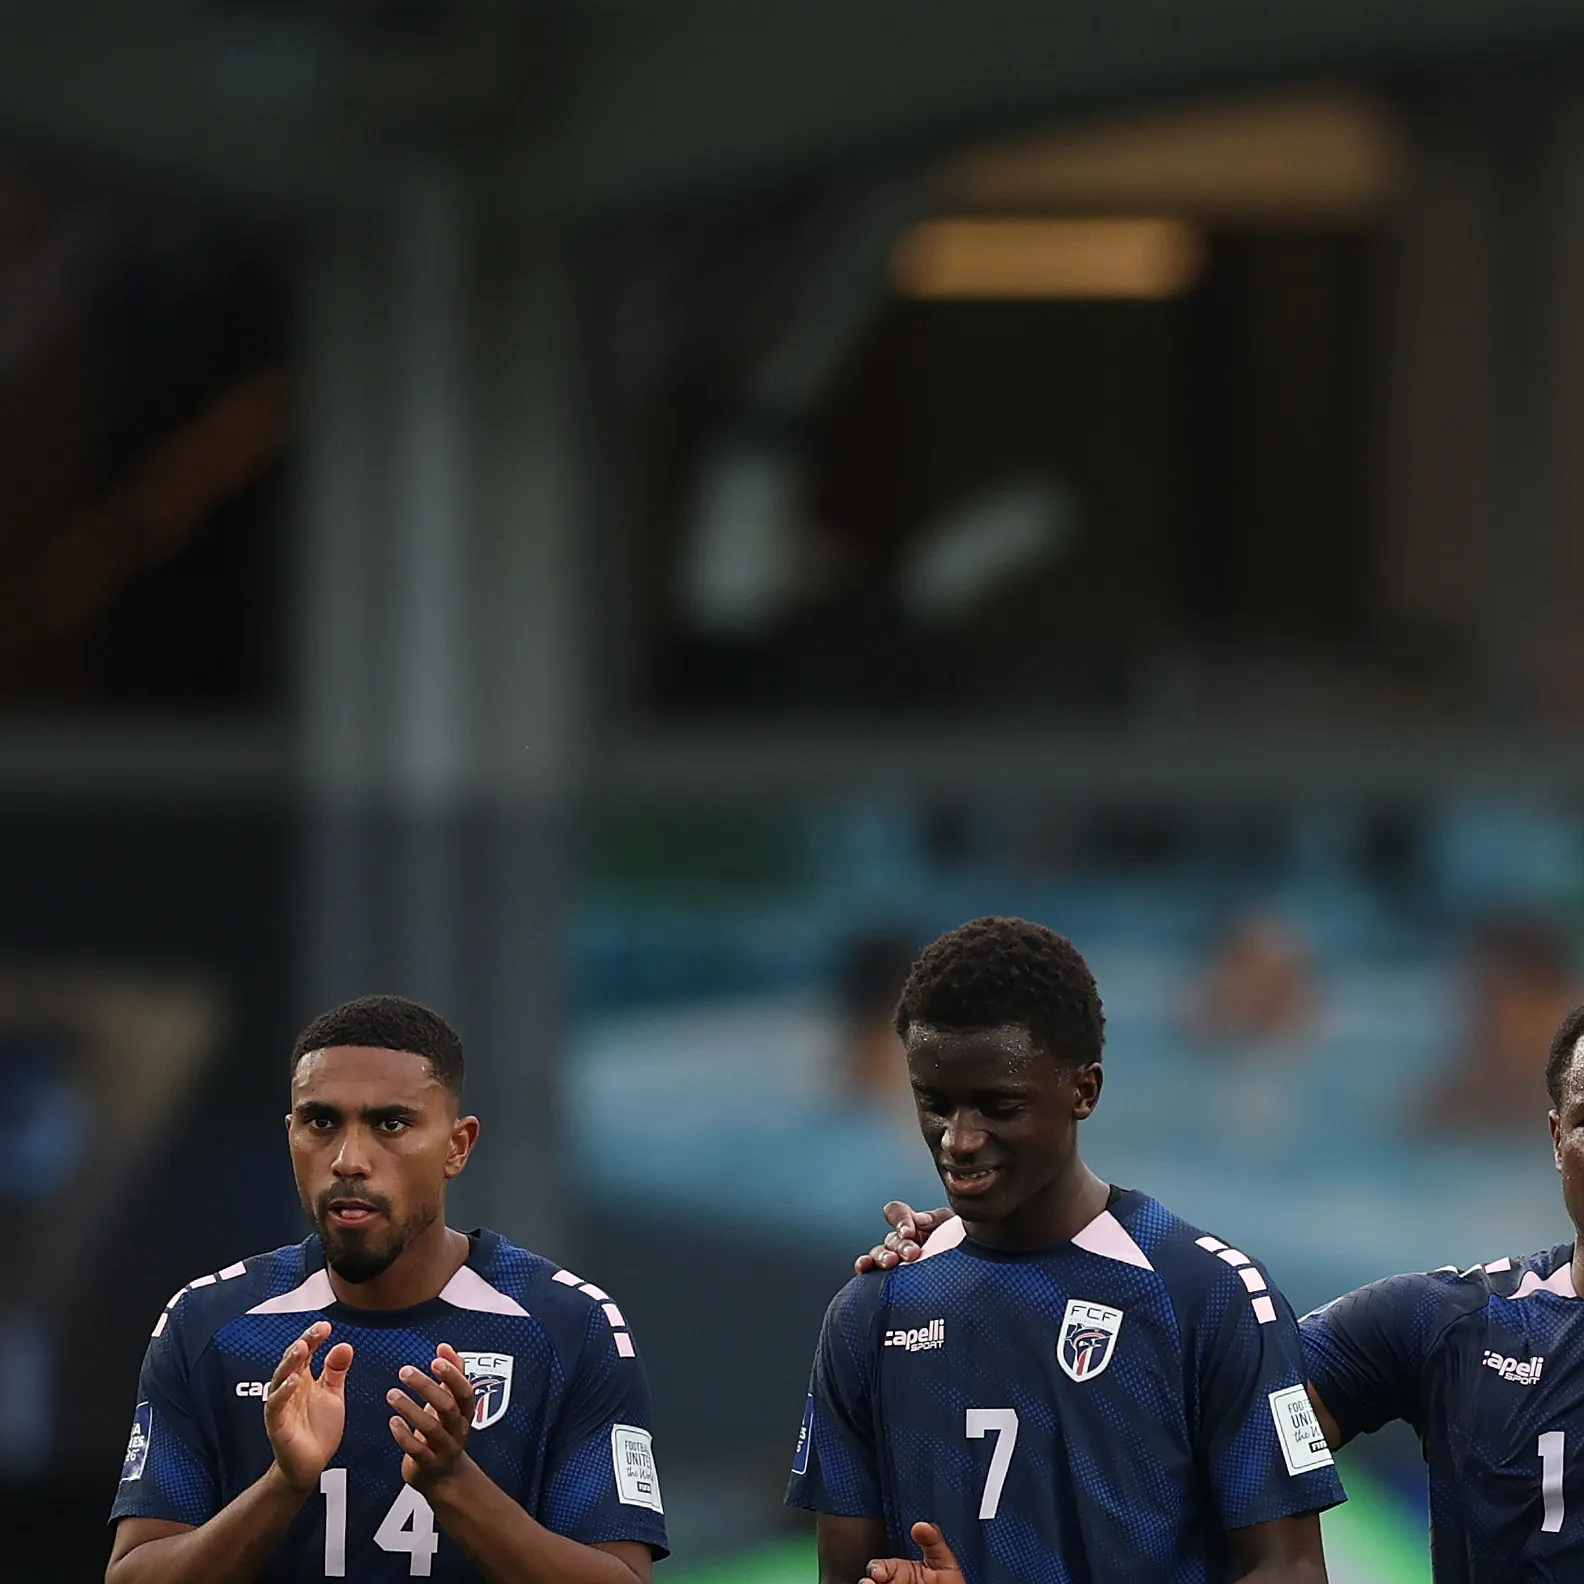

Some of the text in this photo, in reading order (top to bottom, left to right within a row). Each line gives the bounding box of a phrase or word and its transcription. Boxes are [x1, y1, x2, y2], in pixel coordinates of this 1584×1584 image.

[1071, 1305, 1117, 1322] FCF
[965, 1408, 1018, 1519] 7
[320, 1468, 439, 1577] 14
